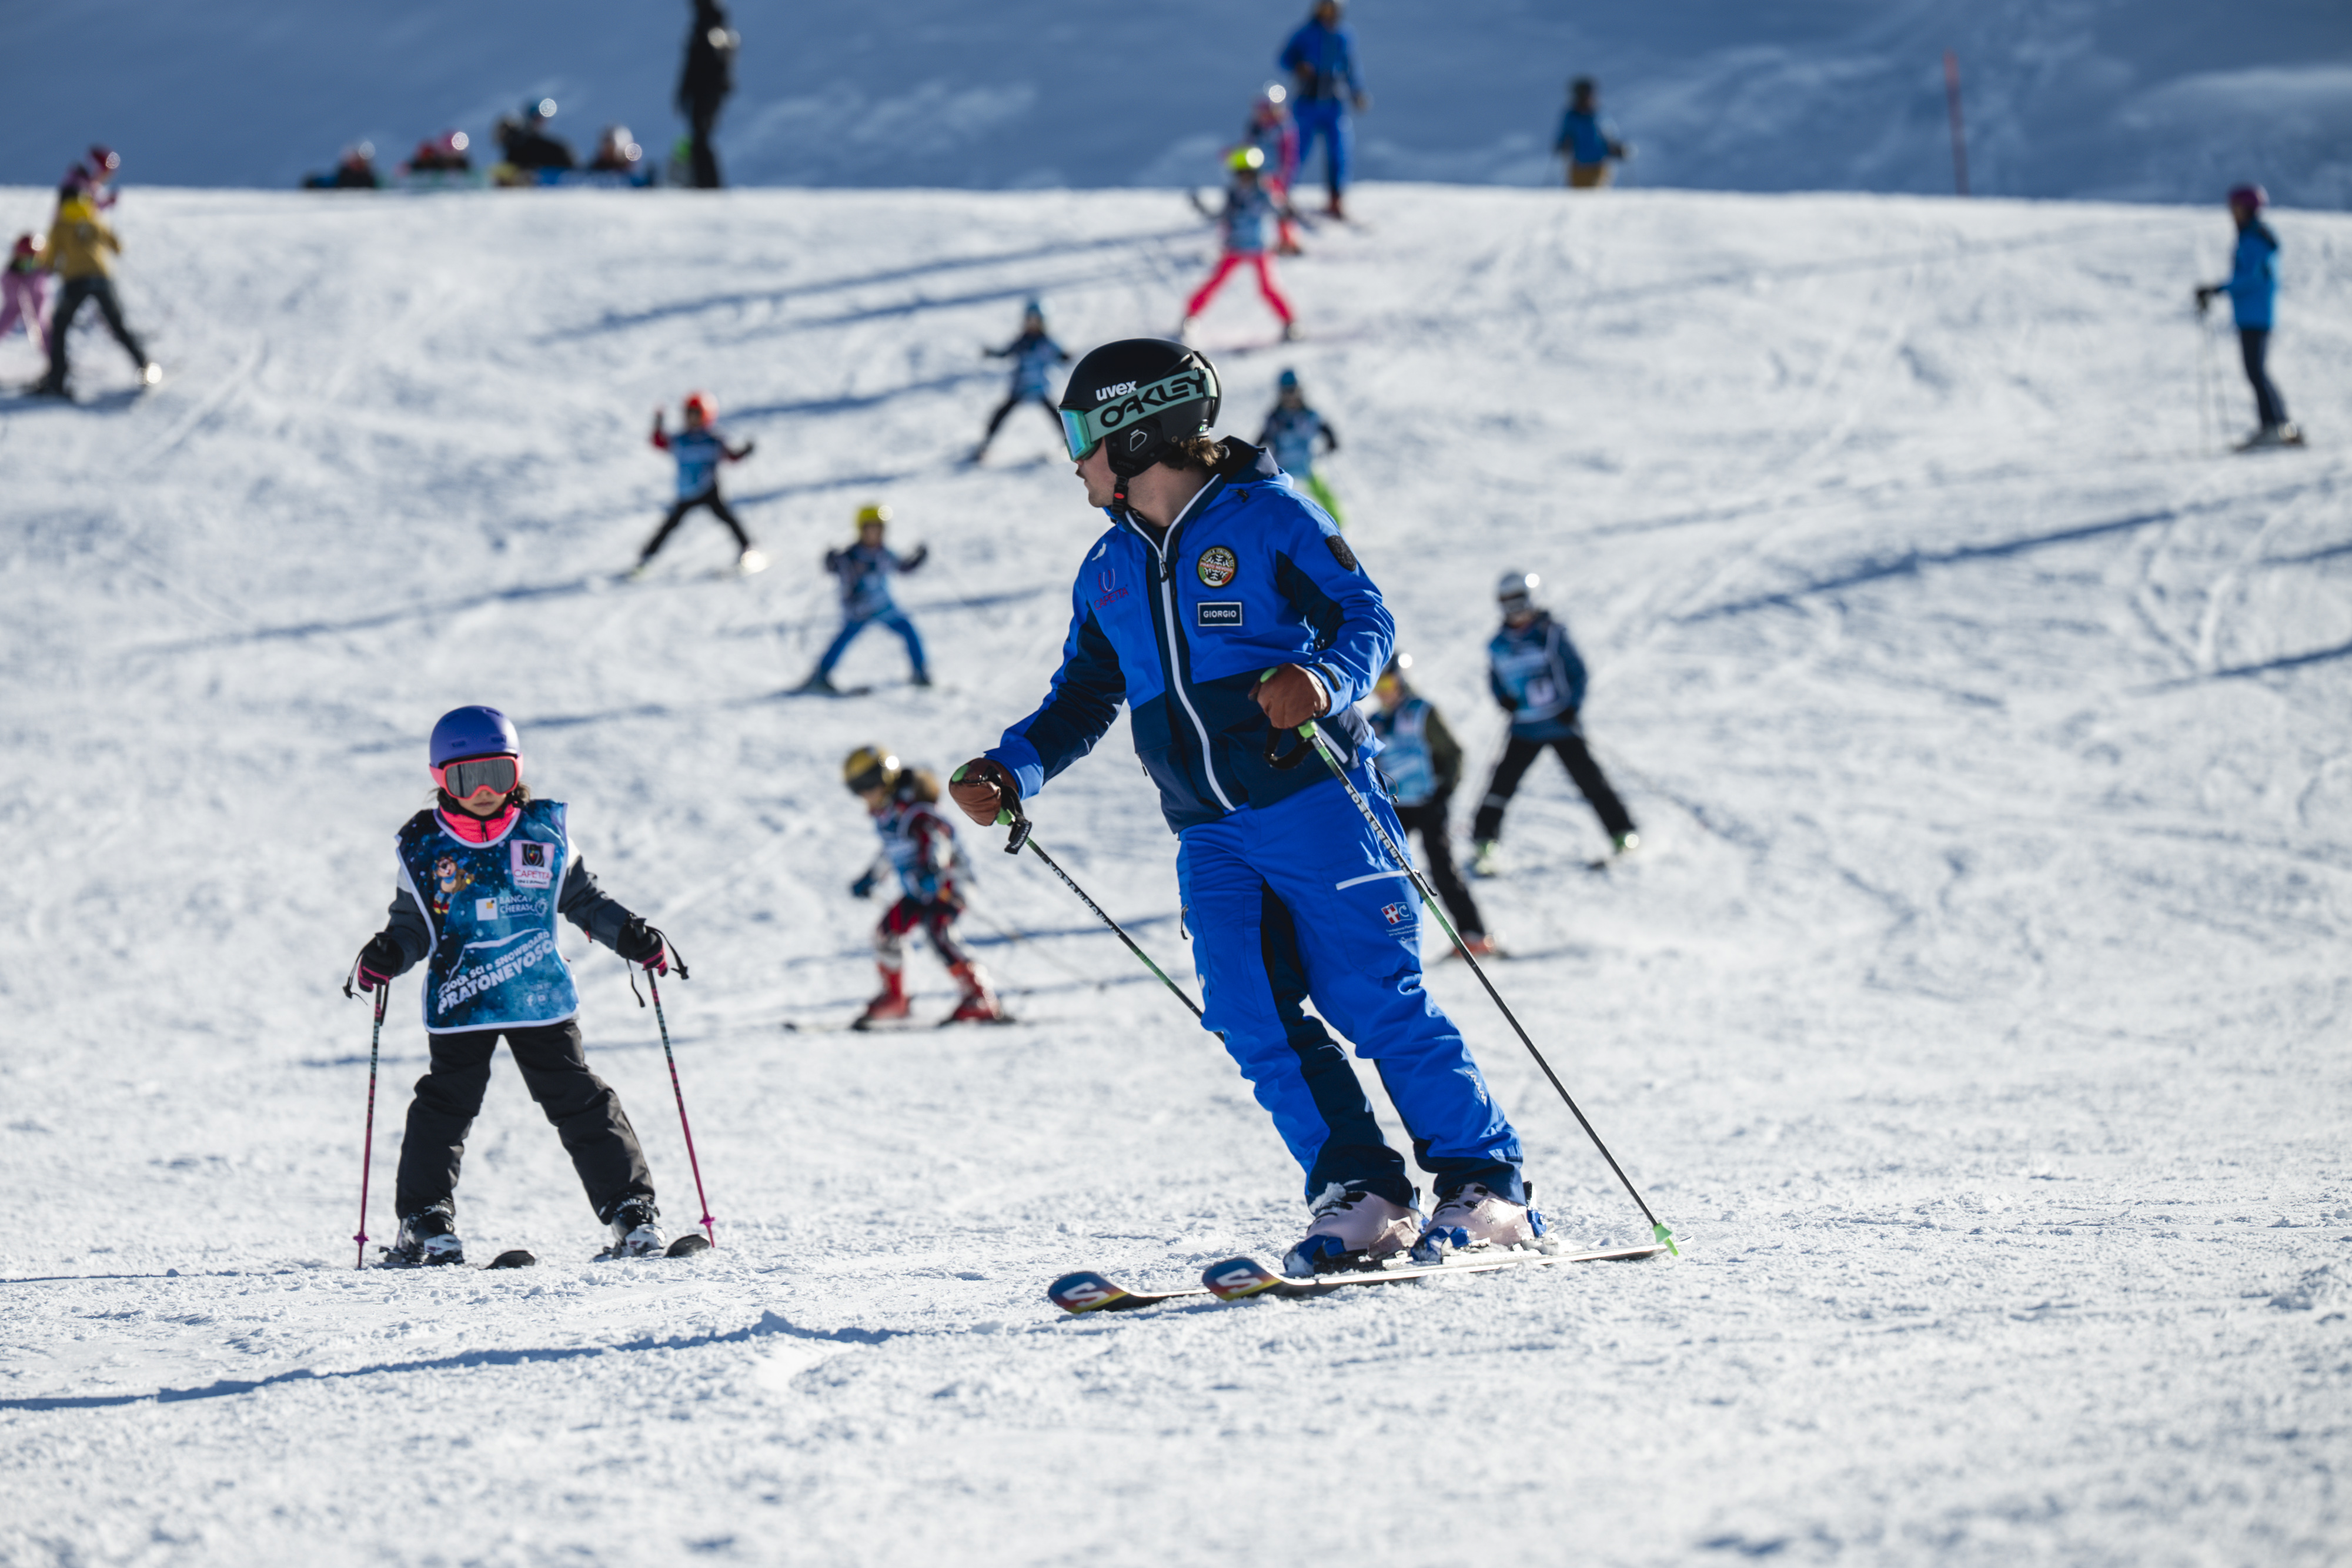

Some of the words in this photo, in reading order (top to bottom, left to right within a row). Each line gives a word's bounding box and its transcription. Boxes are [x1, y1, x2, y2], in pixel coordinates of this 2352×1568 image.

[1095, 381, 1137, 401] uvex
[1100, 375, 1205, 427] OAKLEY
[1094, 587, 1128, 610] CAPETTA
[1203, 610, 1237, 618] GIORGIO
[1345, 784, 1411, 876] KOMPERDELL
[514, 870, 550, 880] CAPETTA
[499, 895, 528, 904] BANCA
[469, 965, 485, 979] SCI
[495, 931, 550, 967] SNOWBOARD
[437, 940, 554, 1015] PRATONEVOSO
